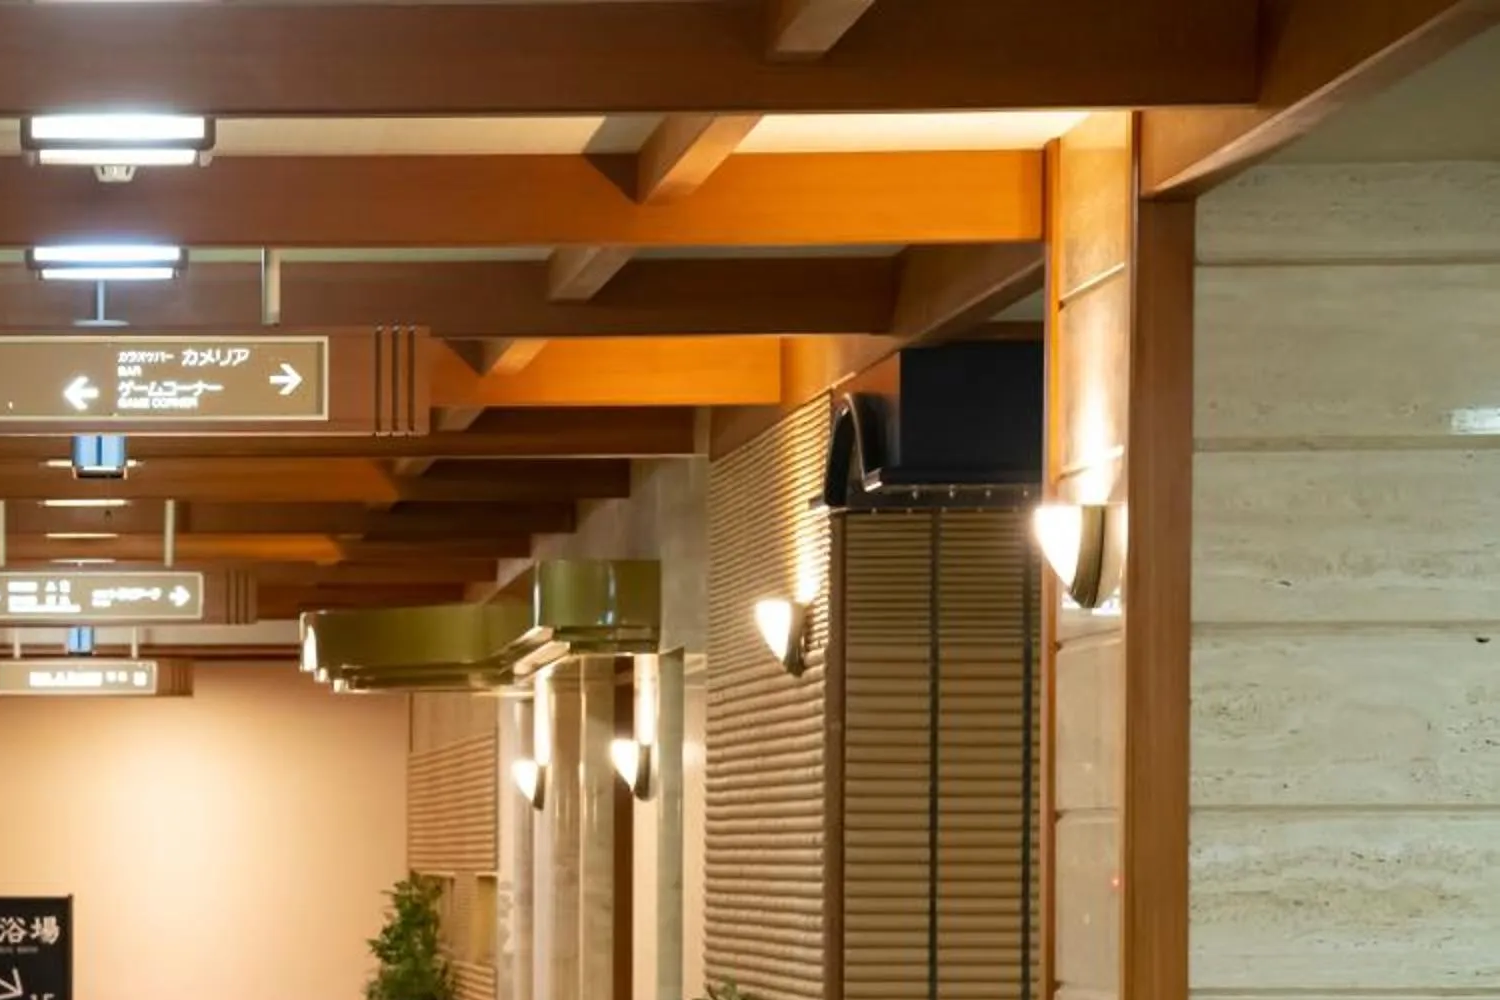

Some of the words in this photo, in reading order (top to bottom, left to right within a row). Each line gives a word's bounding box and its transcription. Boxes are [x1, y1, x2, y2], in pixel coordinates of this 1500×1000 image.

[181, 348, 250, 366] カメリア
[118, 380, 224, 397] ゲームコーナー
